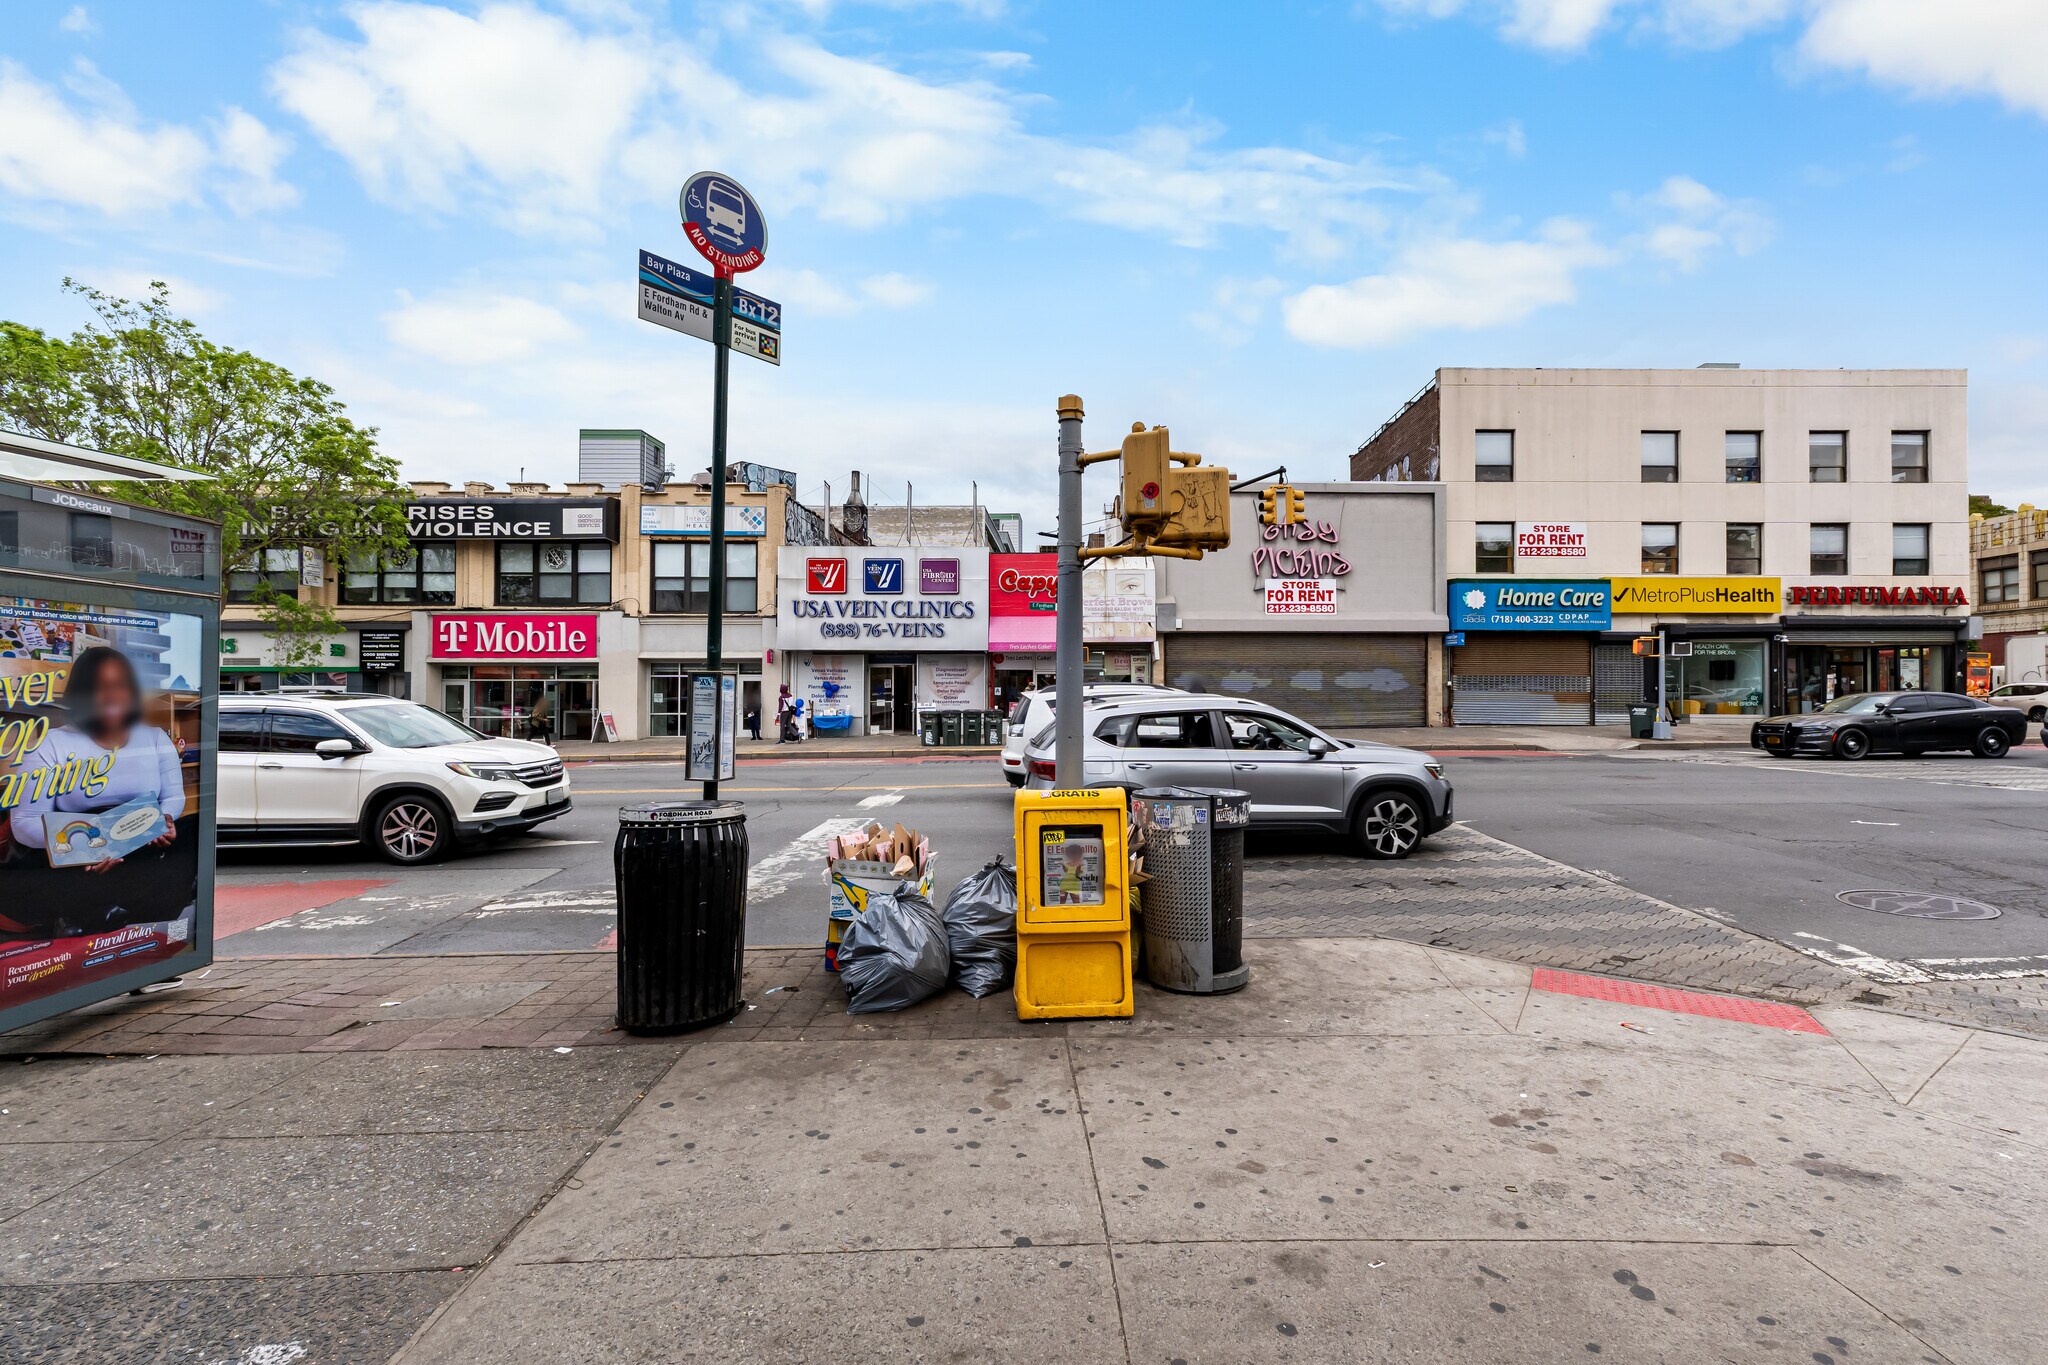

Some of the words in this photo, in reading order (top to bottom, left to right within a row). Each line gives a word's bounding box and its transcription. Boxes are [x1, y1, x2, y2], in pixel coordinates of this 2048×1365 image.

[690, 227, 706, 246] NO
[706, 246, 759, 268] STANDING
[647, 256, 664, 273] Bay
[667, 264, 691, 282] Plaza
[644, 287, 650, 298] E
[652, 291, 687, 312] Fordham
[689, 305, 700, 316] Rd
[702, 308, 708, 319] &
[644, 299, 672, 318] Walton
[674, 311, 685, 322] Av
[739, 298, 779, 326] Bx12
[734, 323, 744, 331] For
[746, 326, 757, 336] bus
[734, 331, 757, 342] arrival
[52, 493, 112, 515] JCDecaux
[408, 506, 494, 520] RISES
[405, 522, 551, 537] VIOLENCE
[1519, 534, 1545, 545] FOR
[1550, 534, 1584, 545] RENT
[1519, 548, 1585, 556] 212-239-8580
[1282, 581, 1320, 589] STORE
[1083, 597, 1116, 606] erfect
[1118, 597, 1153, 606] Brows
[1267, 590, 1293, 601] FOR
[1301, 590, 1334, 601] RENT
[1497, 588, 1556, 607] Home
[1560, 588, 1605, 607] Care
[1631, 587, 1775, 603] MetroPlusHealth
[1789, 586, 1970, 606] PERFUMANIA
[14, 609, 32, 617] your
[32, 610, 59, 618] teacher
[60, 612, 77, 620] voice
[78, 613, 92, 621] with
[99, 616, 120, 624] degree
[127, 618, 156, 626] education
[792, 600, 833, 618] USA
[835, 600, 888, 618] VEIN
[891, 600, 975, 619] CLINICS
[1491, 615, 1513, 624] (718)
[1514, 616, 1554, 624] 400-3232
[474, 621, 587, 653] Mobile
[820, 621, 860, 639] (888)
[863, 622, 945, 638] 76-VEINS
[1052, 790, 1100, 798] GRATIS
[1047, 846, 1055, 854] El
[93, 930, 127, 950] Enroll
[8, 959, 52, 976] Reconnect
[53, 952, 72, 964] with
[7, 972, 29, 987] your
[28, 962, 65, 983] dreams
